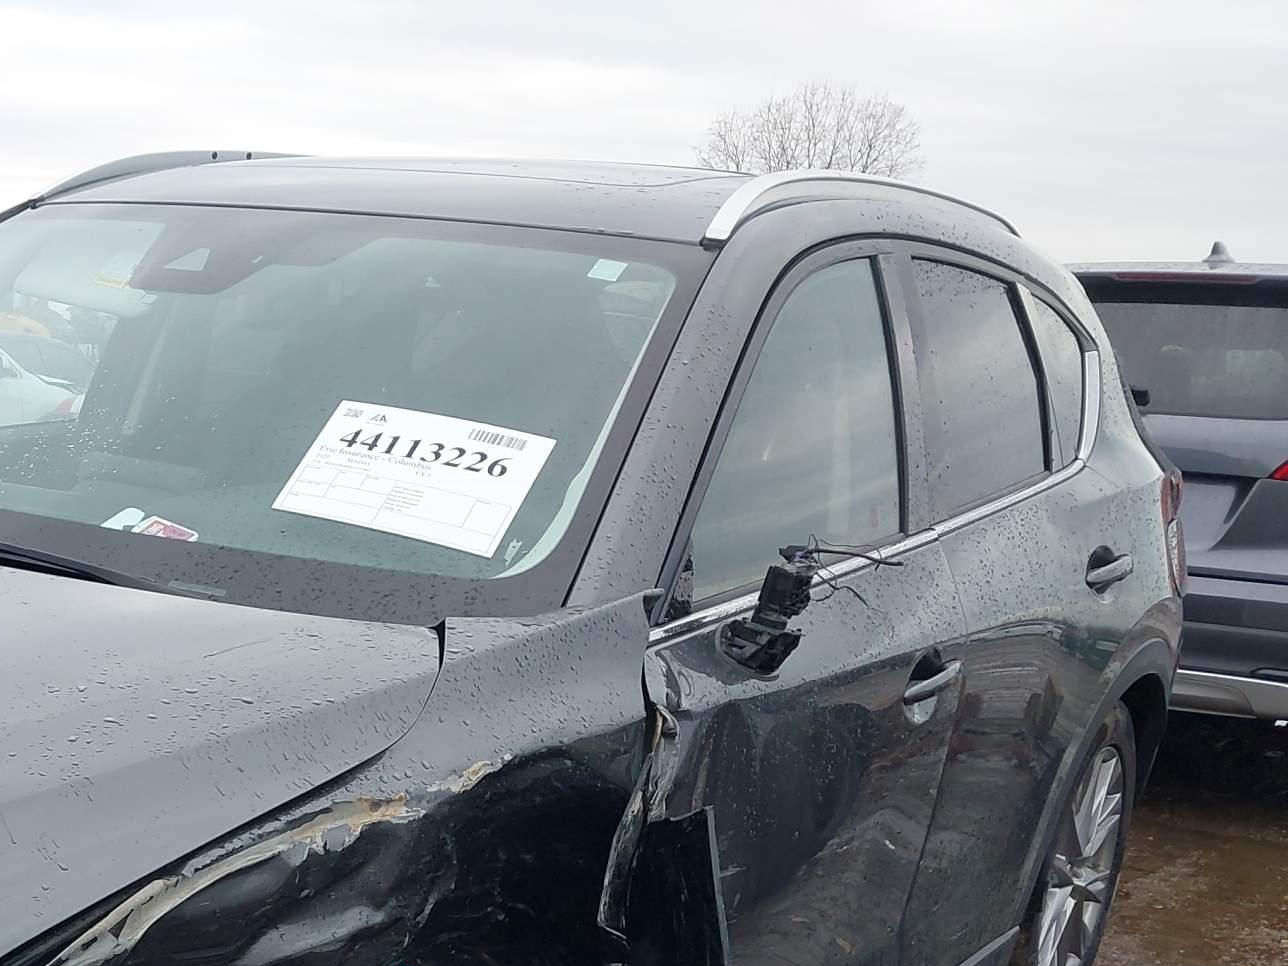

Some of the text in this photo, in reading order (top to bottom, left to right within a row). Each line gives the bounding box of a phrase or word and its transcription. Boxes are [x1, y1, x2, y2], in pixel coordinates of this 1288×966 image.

[339, 429, 515, 478] 44113226
[339, 448, 381, 461] Insurance
[388, 457, 432, 471] Columbus
